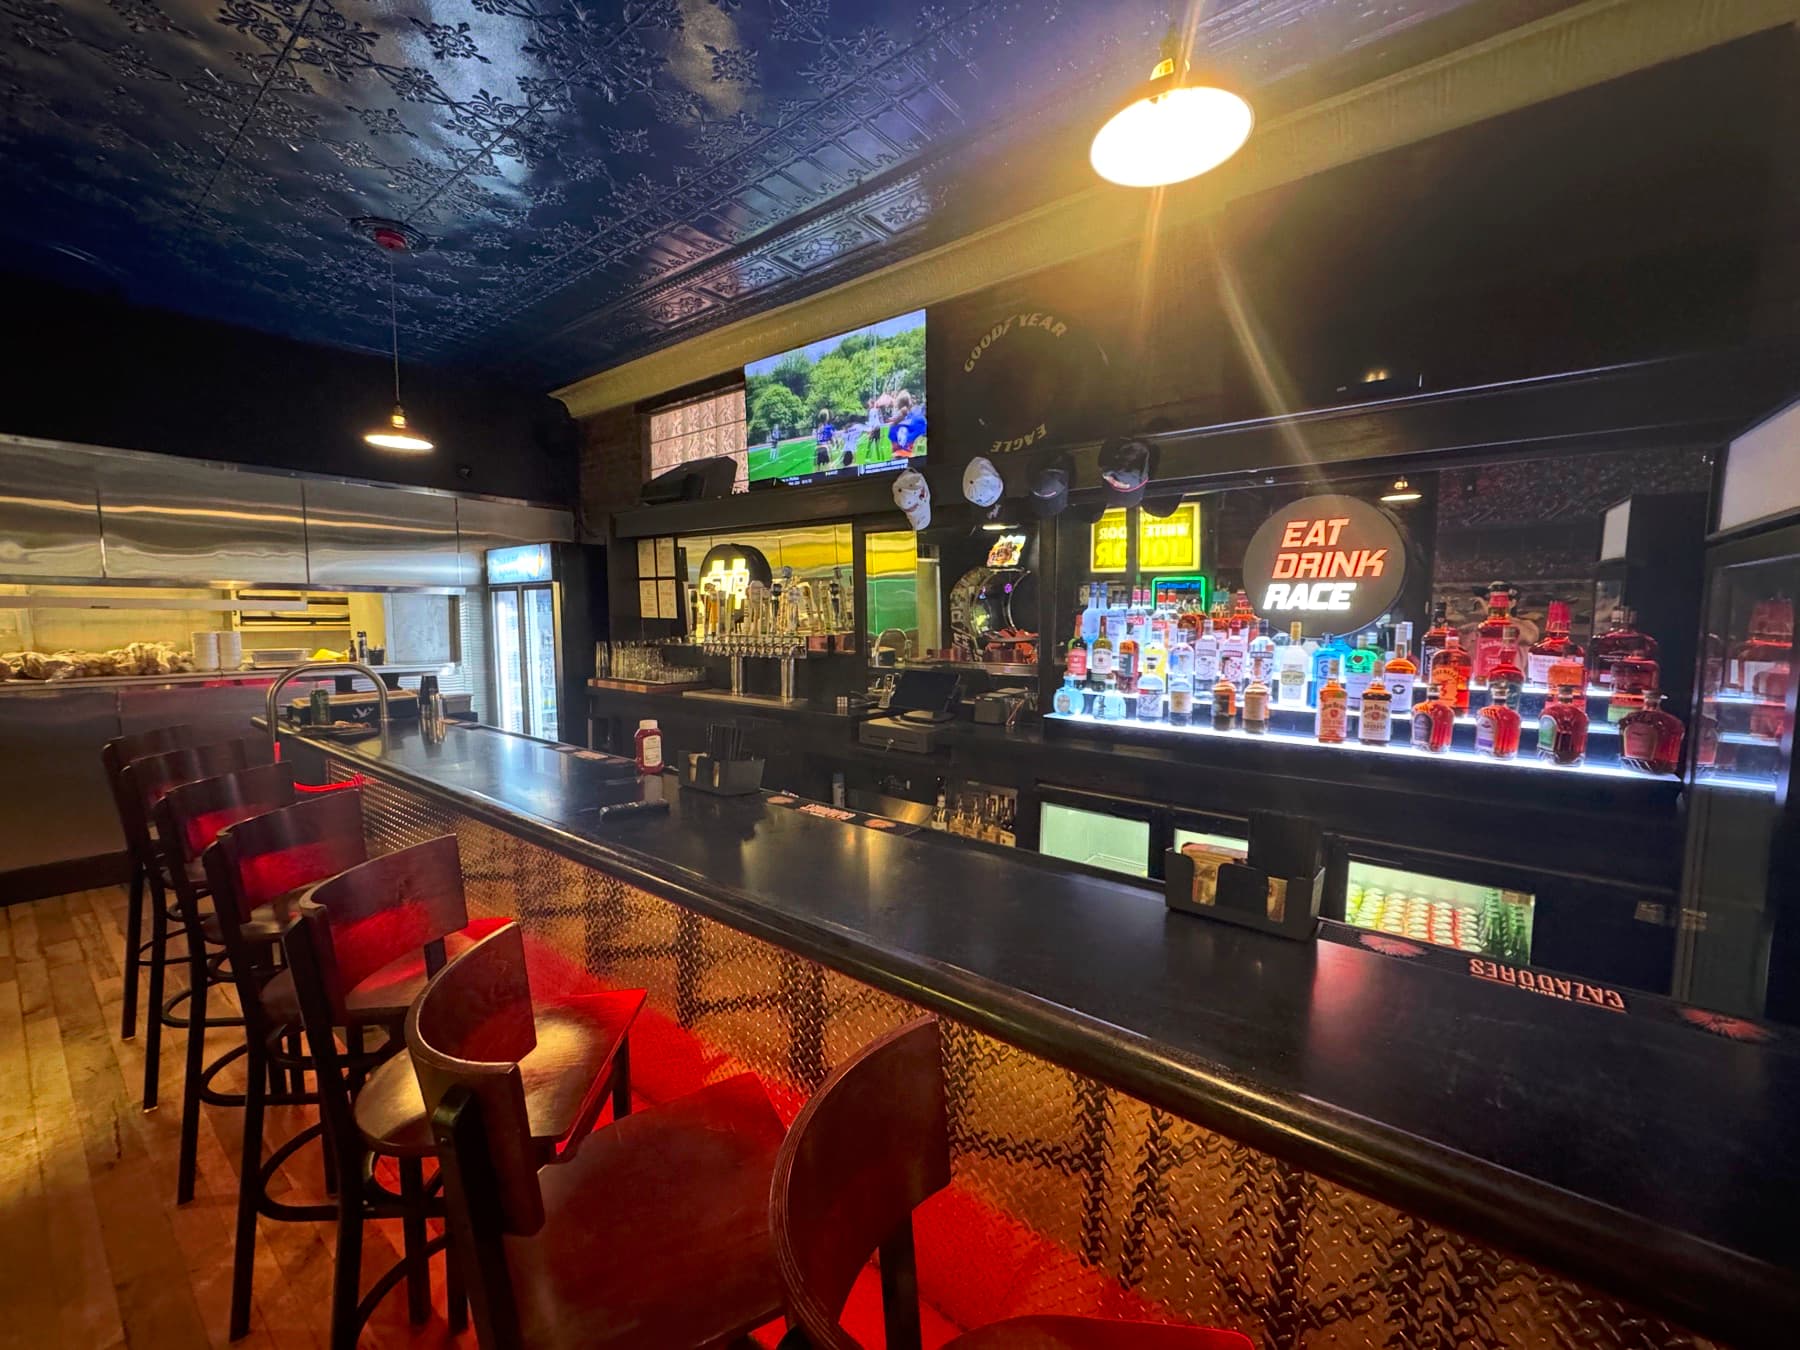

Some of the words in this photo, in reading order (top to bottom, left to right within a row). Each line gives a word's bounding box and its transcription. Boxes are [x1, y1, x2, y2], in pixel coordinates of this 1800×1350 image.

[991, 423, 1048, 452] EAGLE
[1281, 518, 1350, 548] EAT
[1271, 549, 1388, 579] DRINK
[1262, 582, 1357, 610] RACE
[1469, 958, 1625, 1009] CAZADORES
